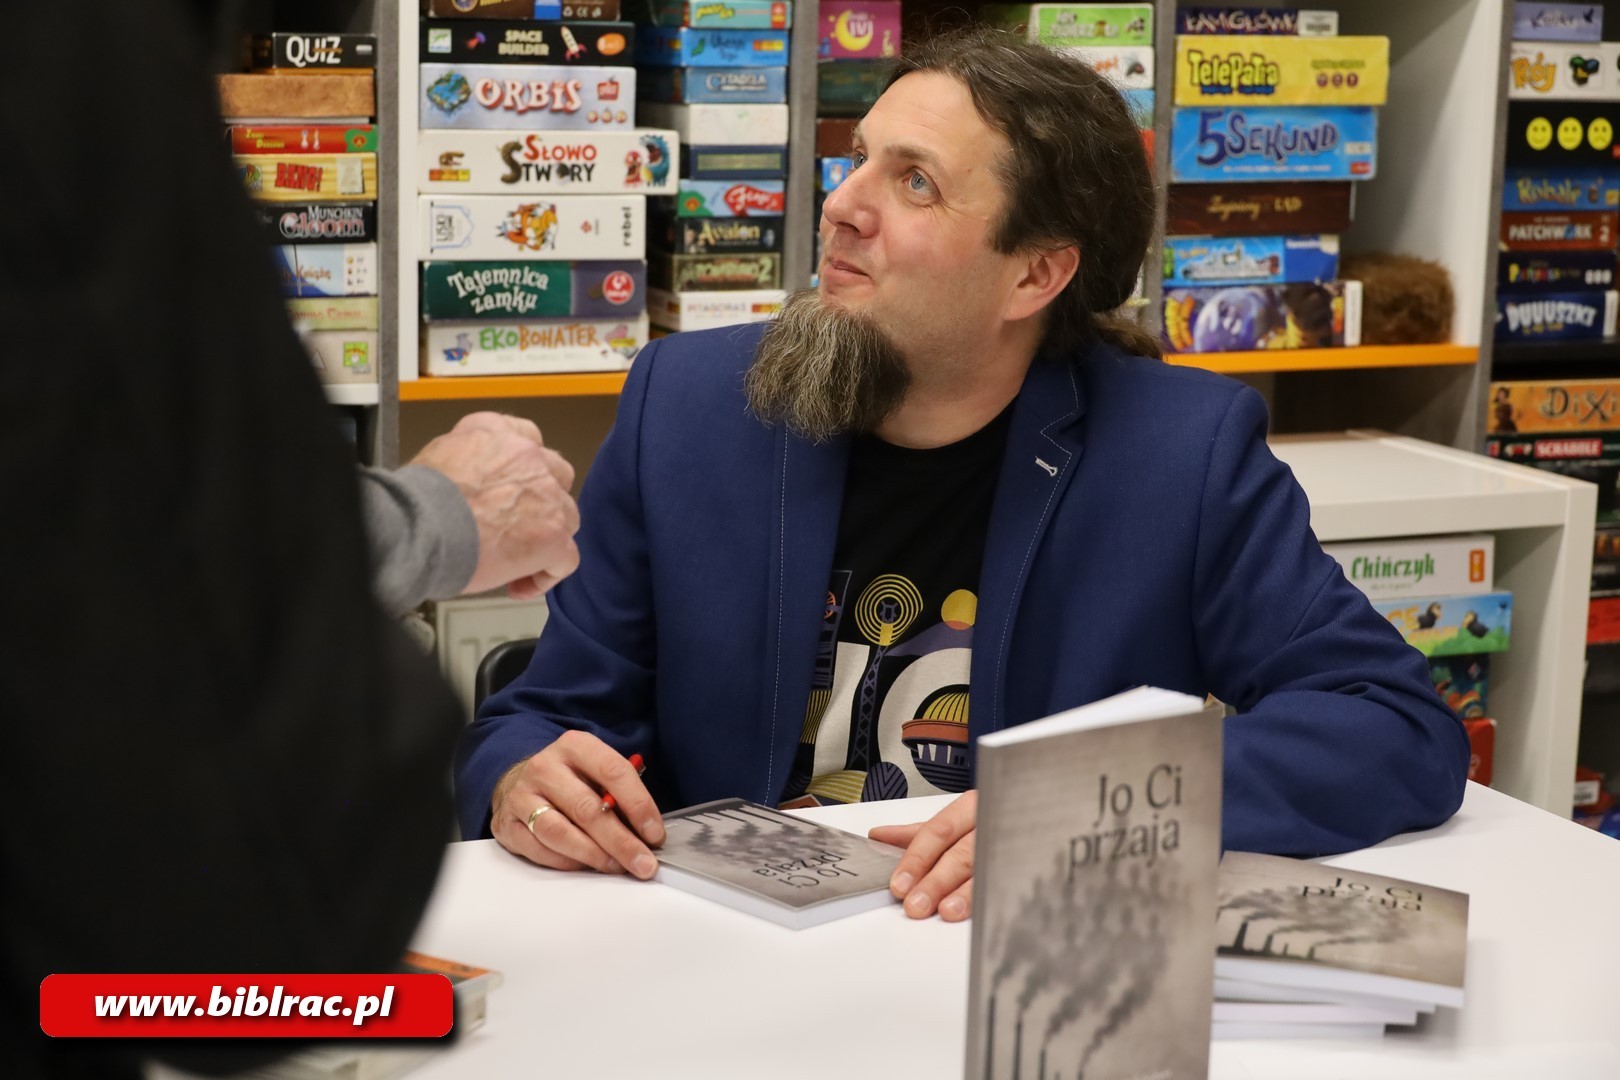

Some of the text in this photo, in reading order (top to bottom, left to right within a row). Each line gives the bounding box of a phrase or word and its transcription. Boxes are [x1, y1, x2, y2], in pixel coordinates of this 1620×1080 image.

[498, 43, 549, 56] BUILDER
[505, 30, 543, 43] SPACE
[286, 36, 341, 67] QUIZ
[524, 134, 597, 161] SŁOWO
[279, 212, 366, 239] Gloom
[307, 205, 363, 220] MUNCHKIN
[621, 206, 632, 246] rebel
[446, 266, 549, 298] Tajemnica
[471, 286, 538, 313] zamku
[1351, 553, 1435, 582] Chińczyk
[1099, 764, 1183, 823] Jo Ci
[1069, 818, 1181, 880] przaja
